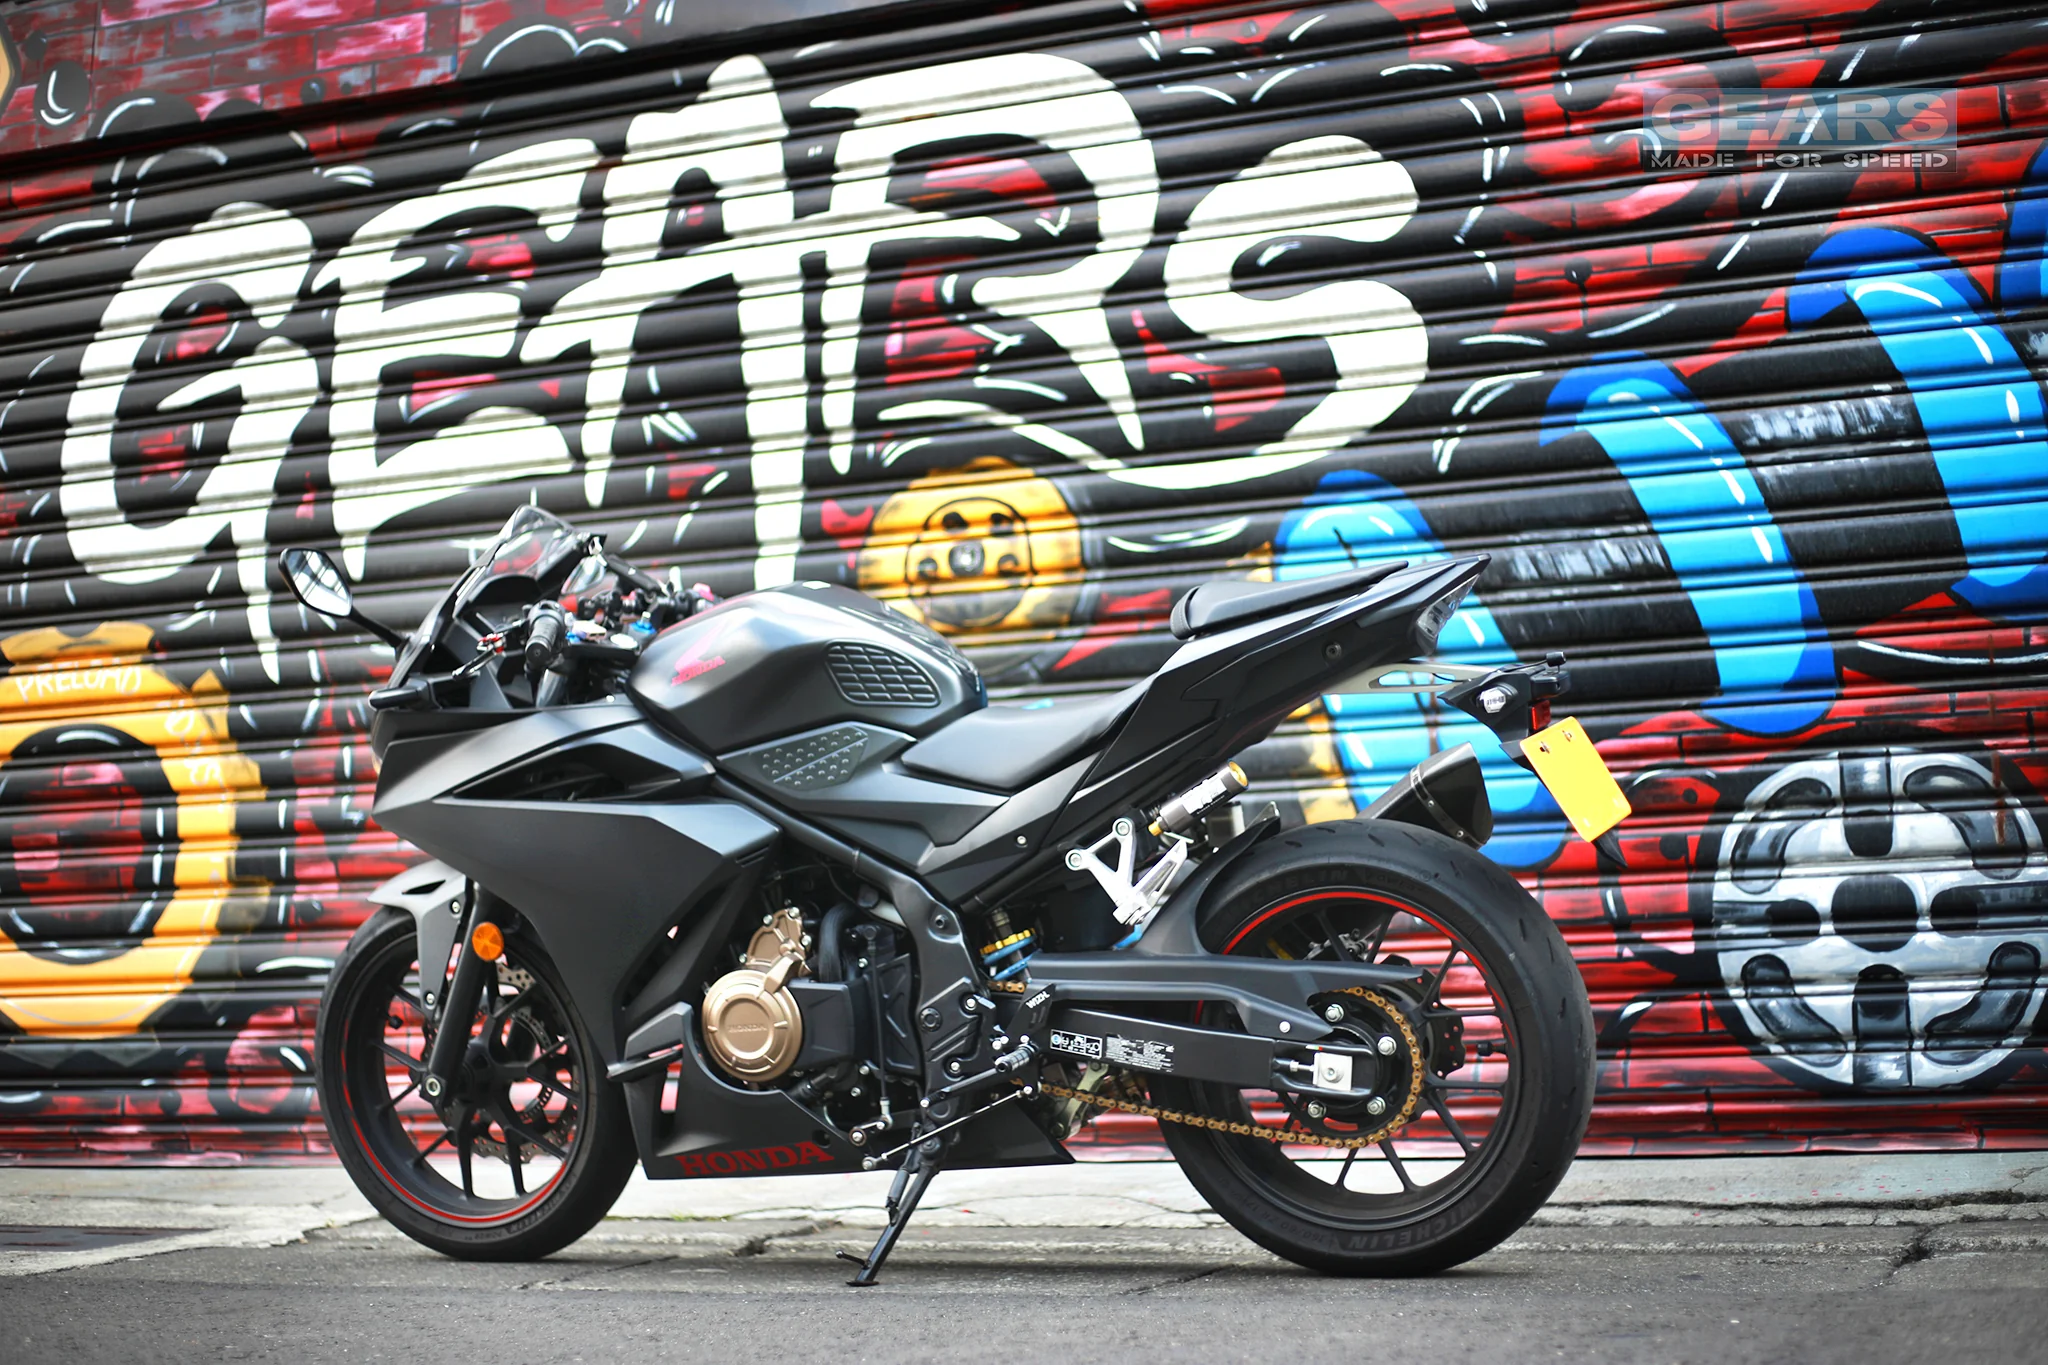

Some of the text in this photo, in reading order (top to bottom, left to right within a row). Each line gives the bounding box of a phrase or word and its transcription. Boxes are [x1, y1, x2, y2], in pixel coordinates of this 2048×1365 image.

[60, 52, 1429, 684] GEARS
[673, 1140, 835, 1177] HONDA
[1347, 1197, 1478, 1250] MICHELIN
